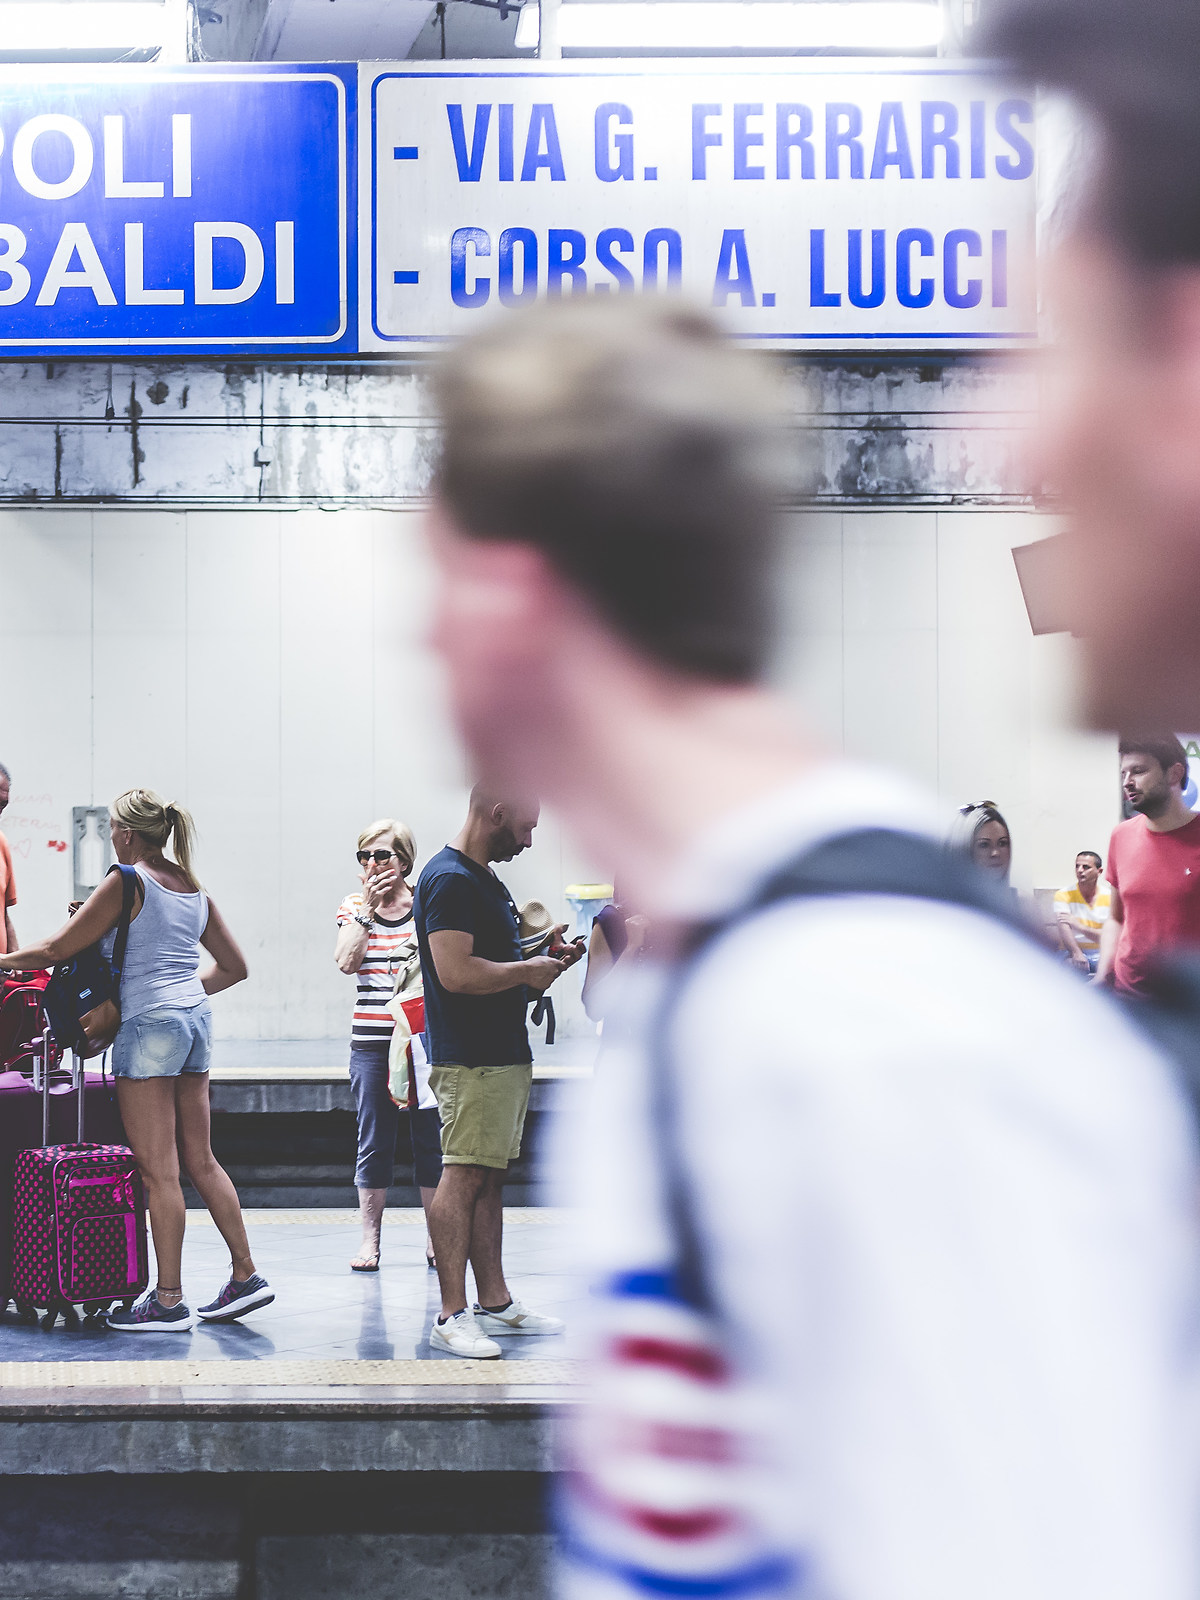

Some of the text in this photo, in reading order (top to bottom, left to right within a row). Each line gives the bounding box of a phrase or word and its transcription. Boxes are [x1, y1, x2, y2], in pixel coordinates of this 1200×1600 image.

[445, 102, 567, 183] VIA
[594, 101, 659, 183] G.
[691, 99, 1036, 182] FERRARIS
[449, 226, 683, 308] CORSO
[710, 227, 777, 308] A.
[808, 227, 1009, 309] LUCCI
